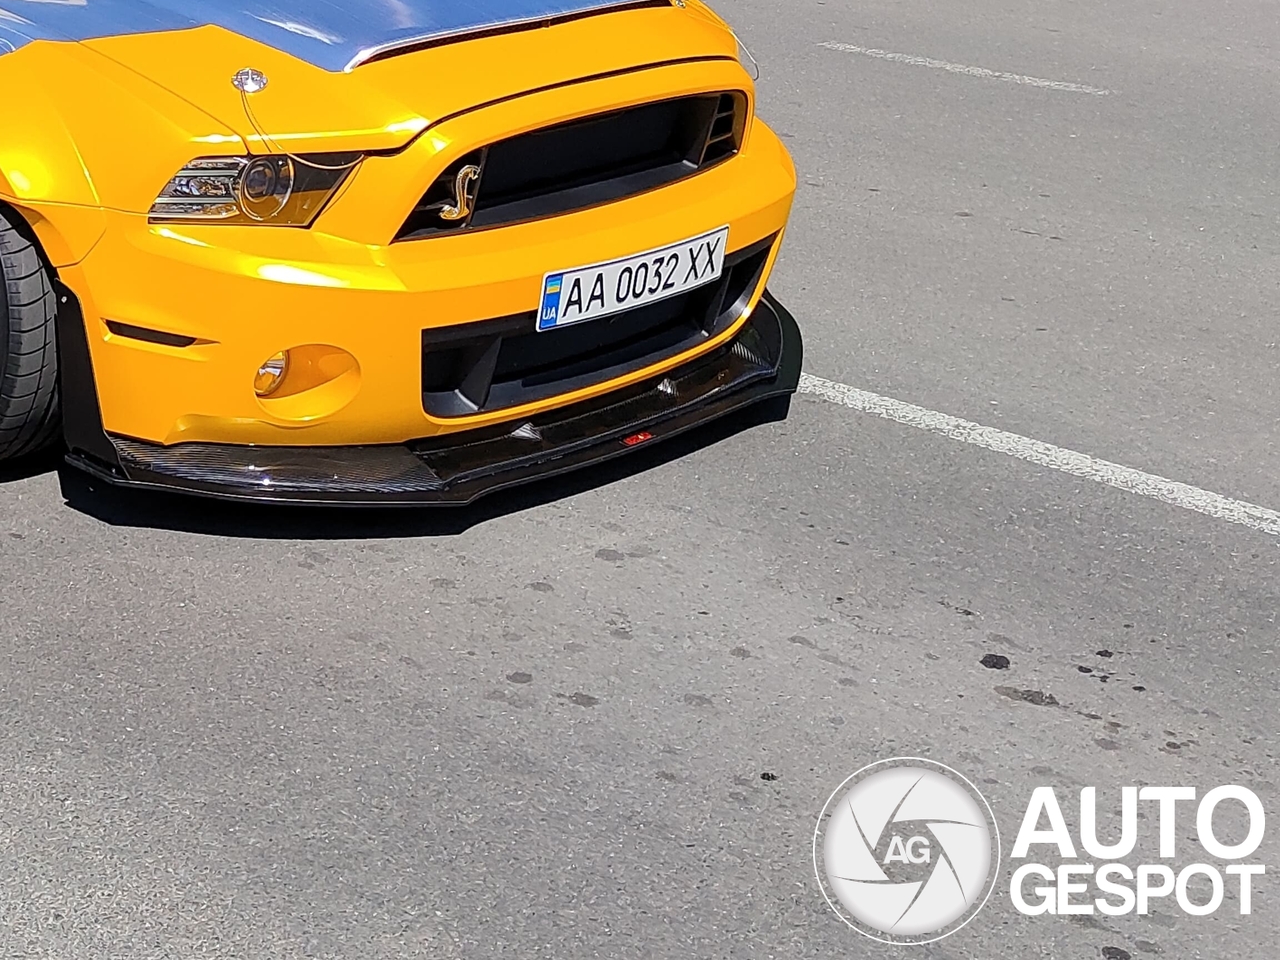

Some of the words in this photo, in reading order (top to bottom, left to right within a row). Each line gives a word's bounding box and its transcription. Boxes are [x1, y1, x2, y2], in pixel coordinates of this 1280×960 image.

[561, 272, 605, 318] AA
[616, 252, 679, 304] 0032
[682, 237, 721, 285] XX
[541, 306, 557, 320] UA
